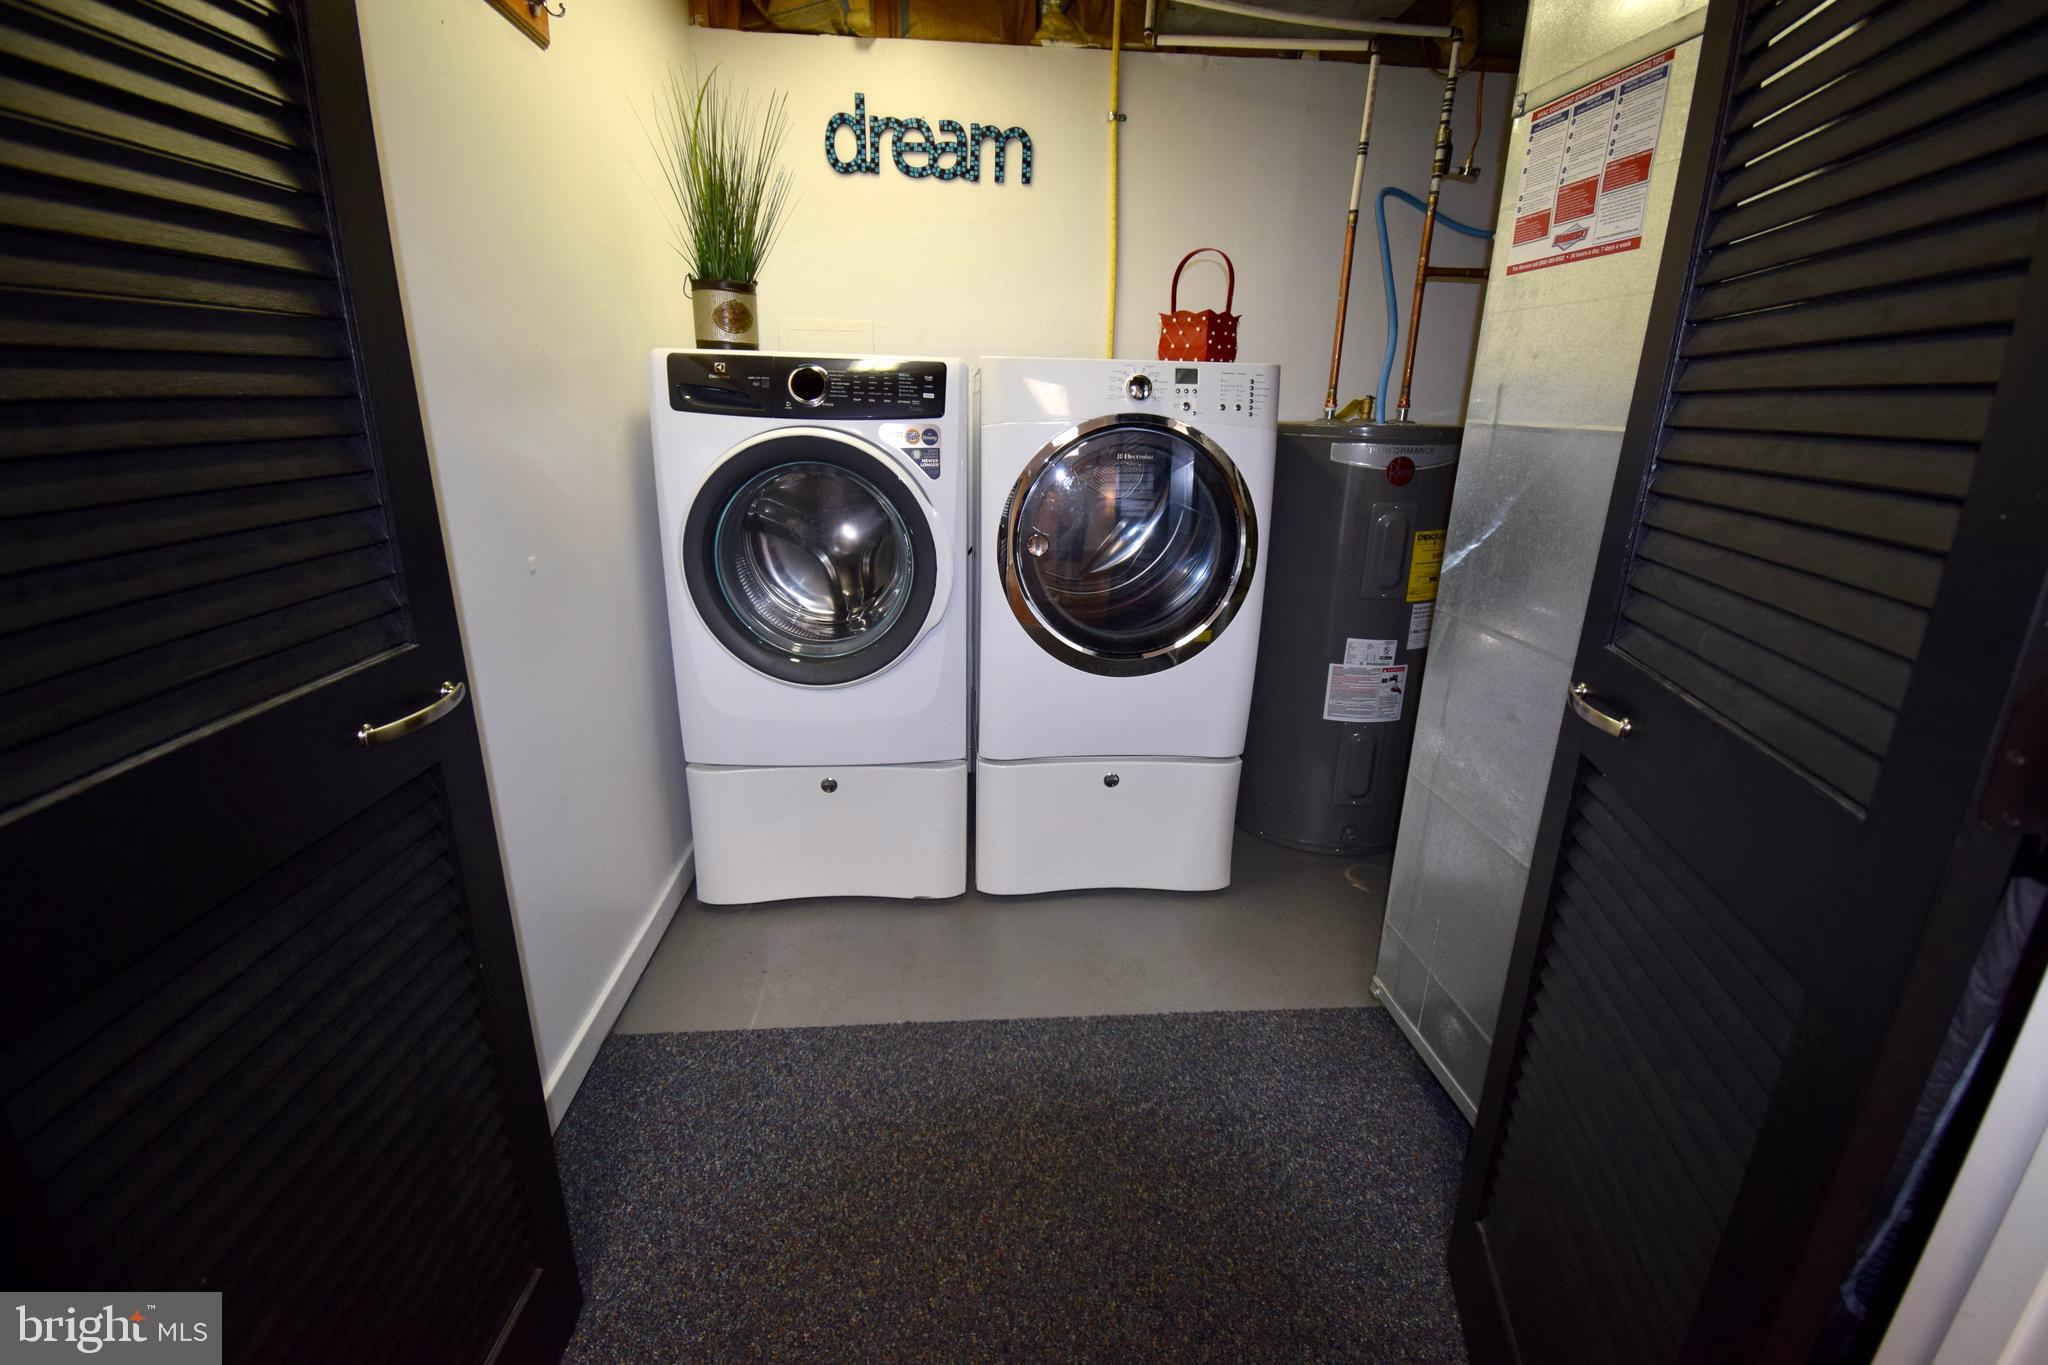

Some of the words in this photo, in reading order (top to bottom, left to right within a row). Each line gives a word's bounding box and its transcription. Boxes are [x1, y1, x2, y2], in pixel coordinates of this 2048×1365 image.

[1601, 61, 1653, 89] TROUBLESHOOTING
[1652, 55, 1665, 67] TIPS
[825, 92, 1032, 184] dream
[1369, 447, 1435, 455] PRFORMANCE
